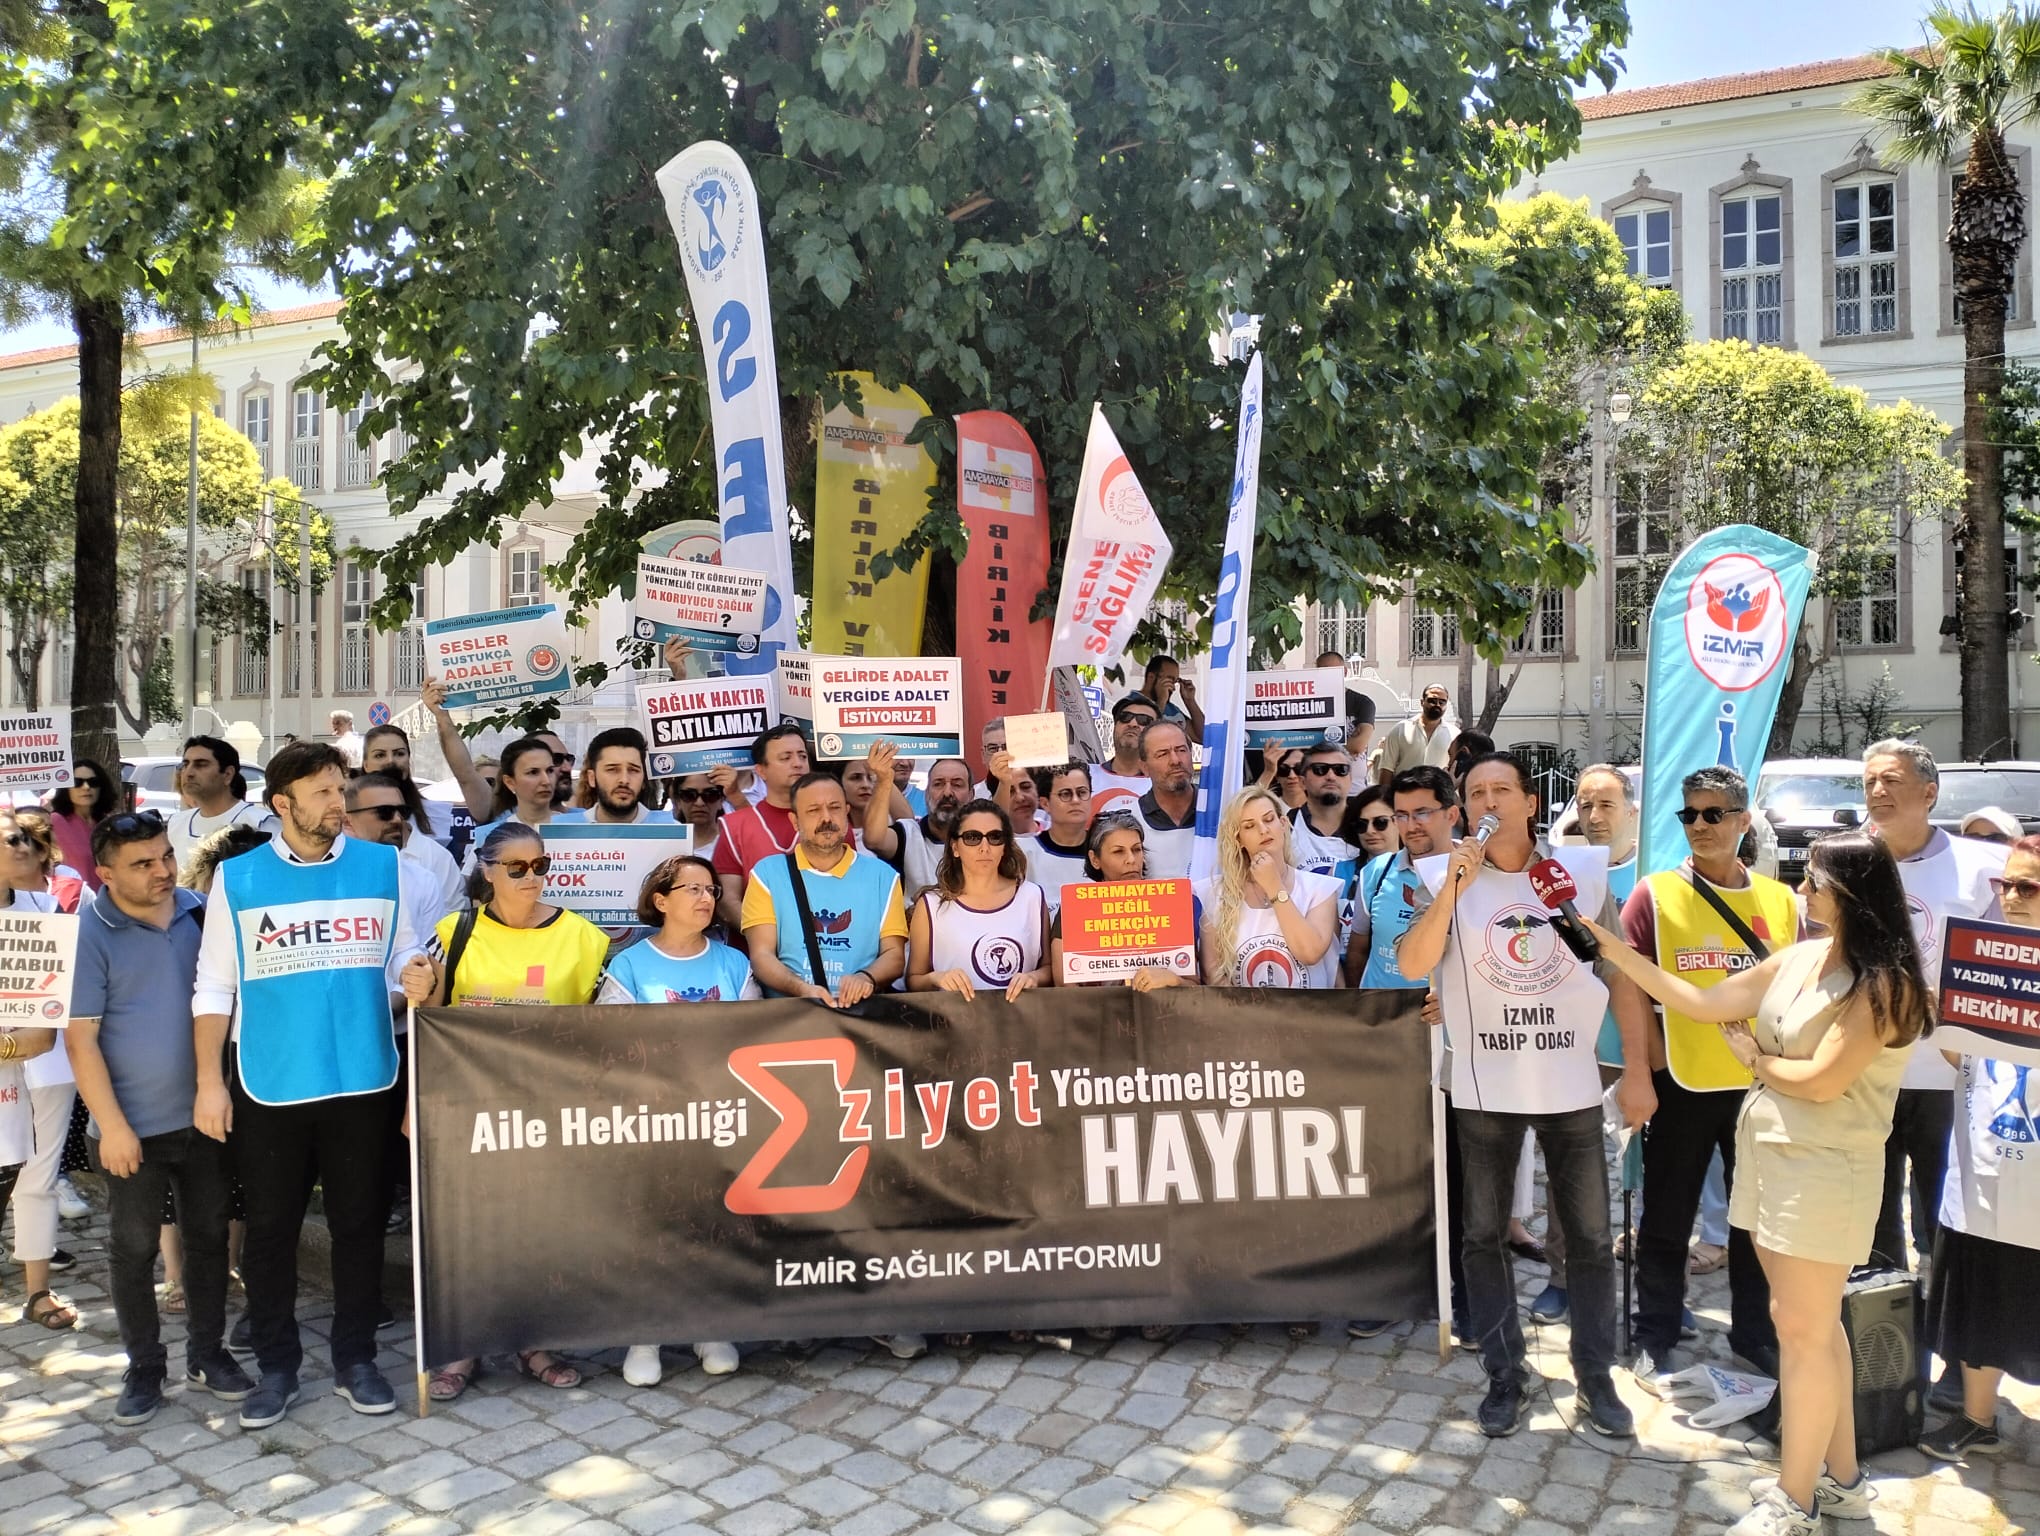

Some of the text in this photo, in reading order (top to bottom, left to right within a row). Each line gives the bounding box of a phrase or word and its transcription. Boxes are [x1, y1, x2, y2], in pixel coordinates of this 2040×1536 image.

[641, 562, 763, 587] BAKANLIĞIN TEK GÖREVİ EZİYET
[645, 574, 757, 597] YÖNETMELİĞİ ÇIKARMAK MI?
[646, 588, 753, 613] YA KORUYUCU SAĞLIK
[677, 608, 718, 623] HİZMETİ
[440, 634, 509, 655] SESLER
[1703, 634, 1763, 662] İZMİR
[442, 649, 512, 666] SUSTUKÇA
[445, 660, 514, 680] ADALET
[823, 668, 949, 683] GELİRDE ADALET
[447, 674, 518, 693] KAYBOLUR
[787, 685, 800, 697] YA
[1255, 680, 1315, 697] BİRLİKTE
[647, 688, 765, 715] SAĞLIK HAKTIR
[823, 688, 950, 703] VERGİDE ADALET
[843, 708, 922, 724] İSTİYORUZ
[1246, 700, 1326, 719] DEĞİŞTİRELİM
[656, 711, 764, 743] SATILAMAZ
[6, 772, 51, 783] SAĞLIK-İŞ
[450, 814, 477, 827] İCA
[575, 849, 625, 860] SAĞLIĞI
[550, 863, 626, 873] ALIŞANLARINI
[544, 874, 586, 887] YOK
[542, 890, 624, 898] SAYAMAZSINIZ
[1075, 883, 1176, 899] SERMAYEYE
[601, 908, 627, 921] SAĞLIK
[1102, 898, 1152, 915] DEĞİL
[1084, 915, 1171, 932] EMEKÇİYE
[1099, 933, 1157, 948] BÜTÇE
[1, 958, 65, 973] KABUL
[256, 968, 265, 976] YA
[268, 966, 284, 974] HEP
[1088, 955, 1171, 970] GENEL SAĞLIK-İŞ
[1487, 954, 1561, 980] TÜRK TABİPLERİ BİRLİĞİ
[1489, 973, 1562, 993] İZMİR TABİP ODASI
[1952, 967, 2008, 989] YAZDIN,
[0, 1001, 36, 1016] IK-İŞ
[1503, 1003, 1555, 1026] İZMİR
[1953, 995, 2040, 1028] HEKİM K
[1478, 1028, 1575, 1051] TABİP ODASI
[470, 1109, 547, 1153] Aile
[560, 1098, 748, 1147] Hekimliği
[1051, 1060, 1305, 1107] Yönetmeliğine
[1997, 1125, 2027, 1140] 1996
[1081, 1106, 1370, 1208] HAYIR!
[1995, 1145, 2024, 1161] SES
[775, 1243, 1161, 1287] İZMİR SAĞLIK PLATFORMU
